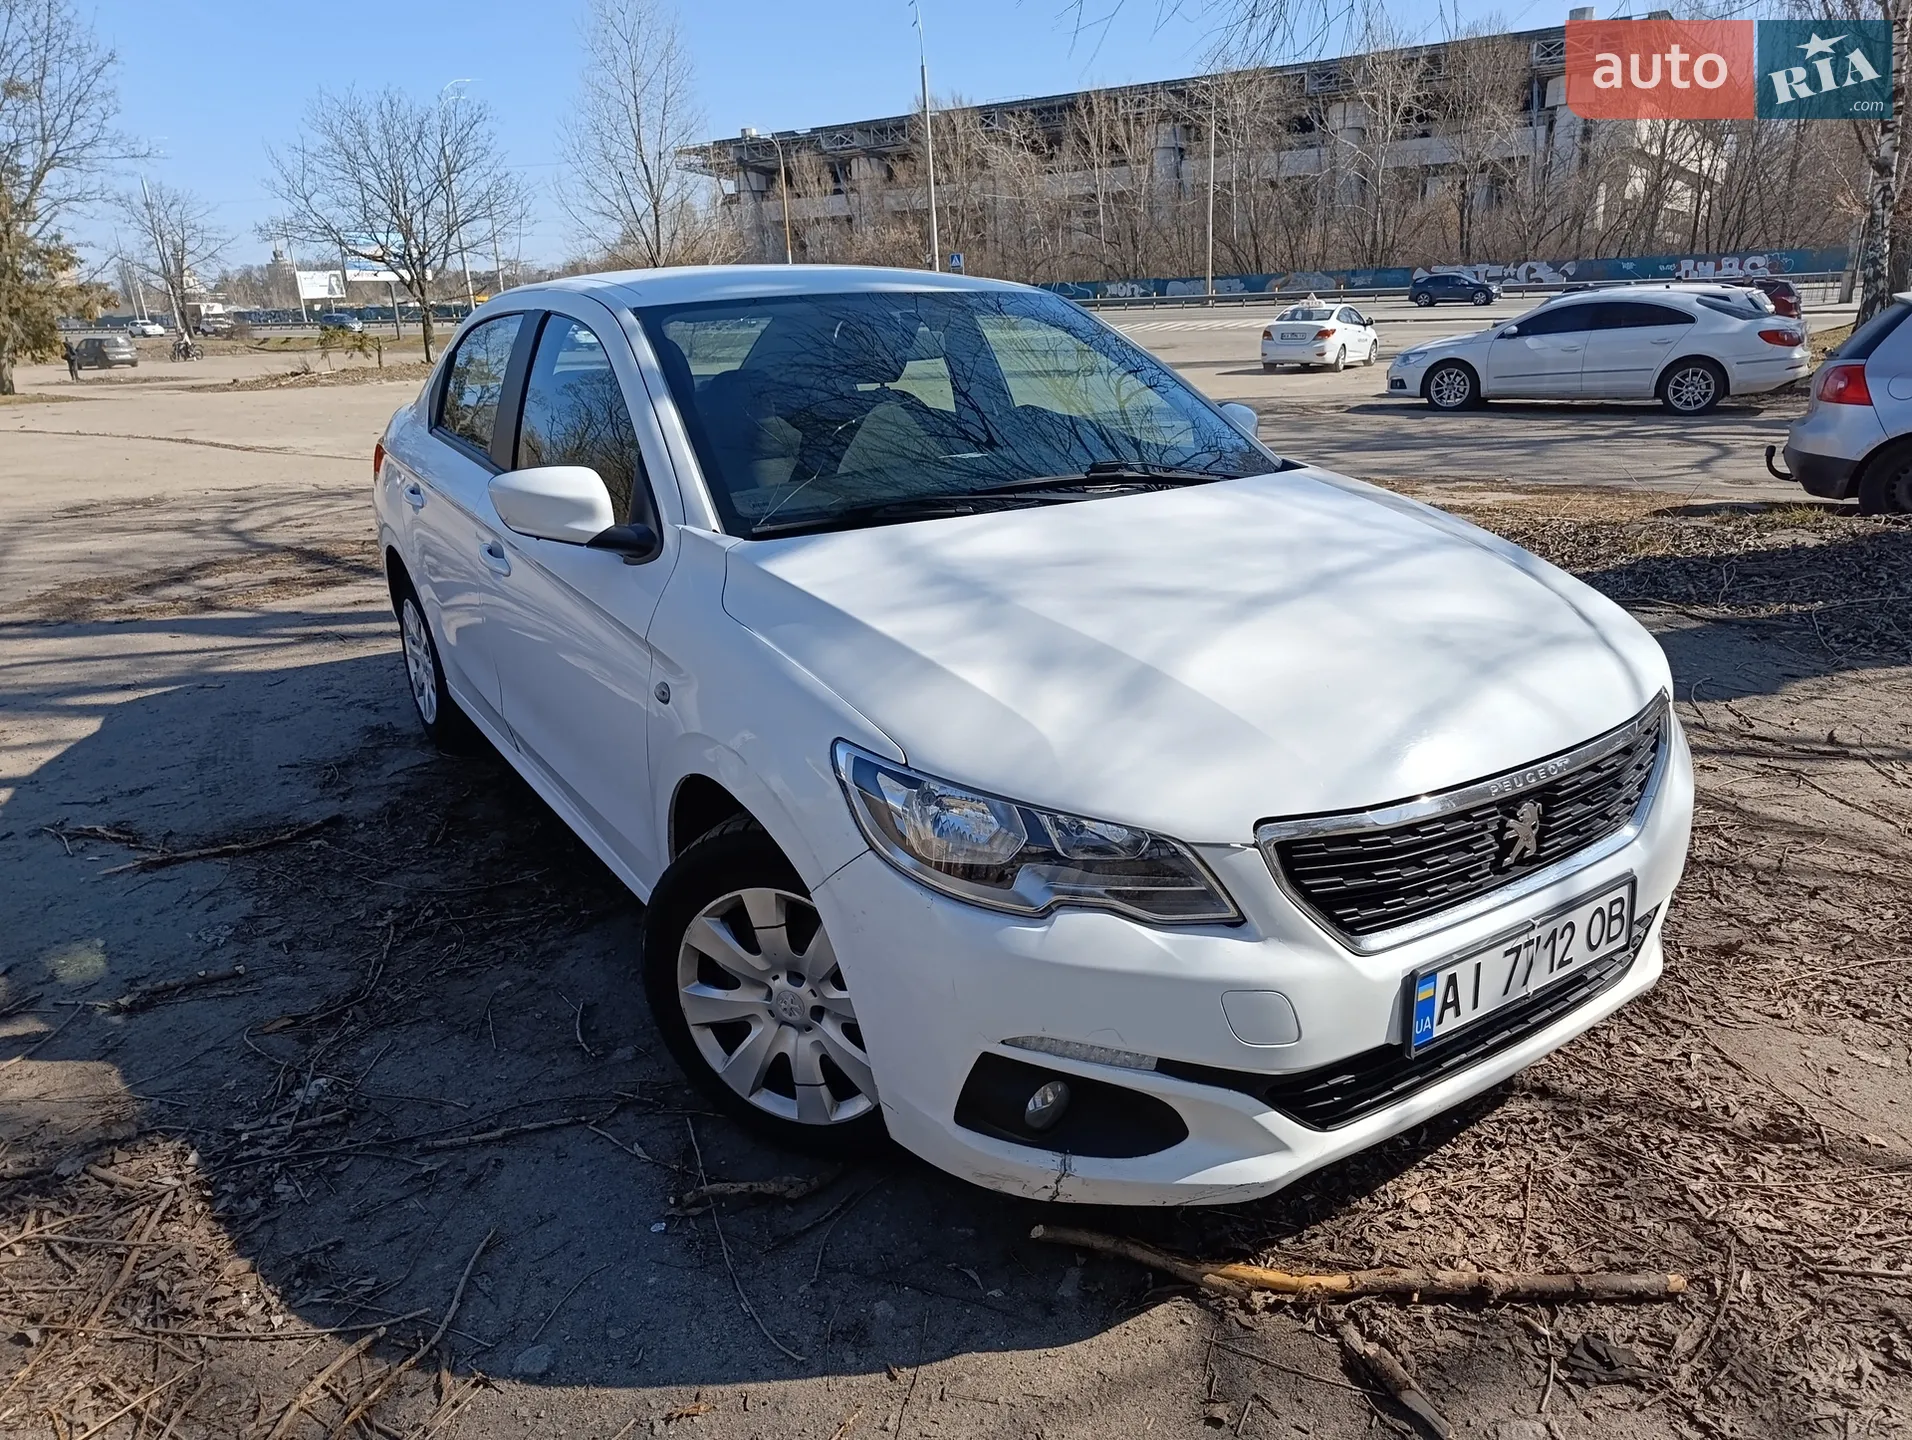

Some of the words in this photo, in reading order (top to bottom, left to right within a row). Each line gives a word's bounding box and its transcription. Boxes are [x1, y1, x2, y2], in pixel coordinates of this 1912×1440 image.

[1489, 759, 1570, 796] PEUGEOT
[1436, 962, 1482, 1026] AI
[1503, 921, 1576, 997] 7712
[1586, 896, 1625, 952] OB
[1415, 1019, 1432, 1035] UA
